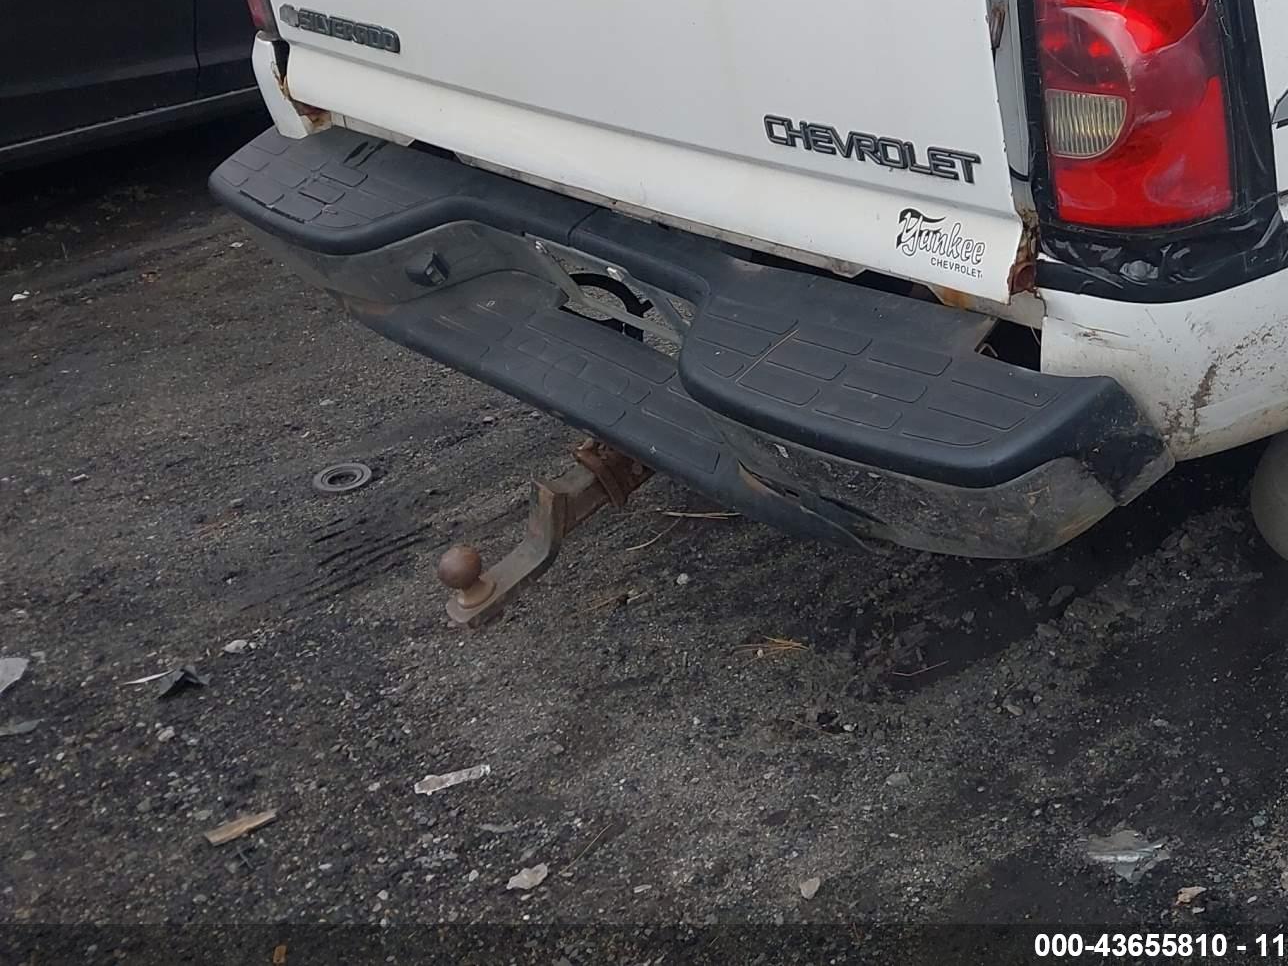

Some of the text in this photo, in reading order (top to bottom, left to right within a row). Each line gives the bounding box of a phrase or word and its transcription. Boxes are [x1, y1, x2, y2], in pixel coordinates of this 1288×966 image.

[298, 7, 401, 54] SILVERADO
[763, 113, 982, 184] CHEVROLET
[896, 207, 986, 264] Yankee
[929, 256, 983, 278] CHEVROLET
